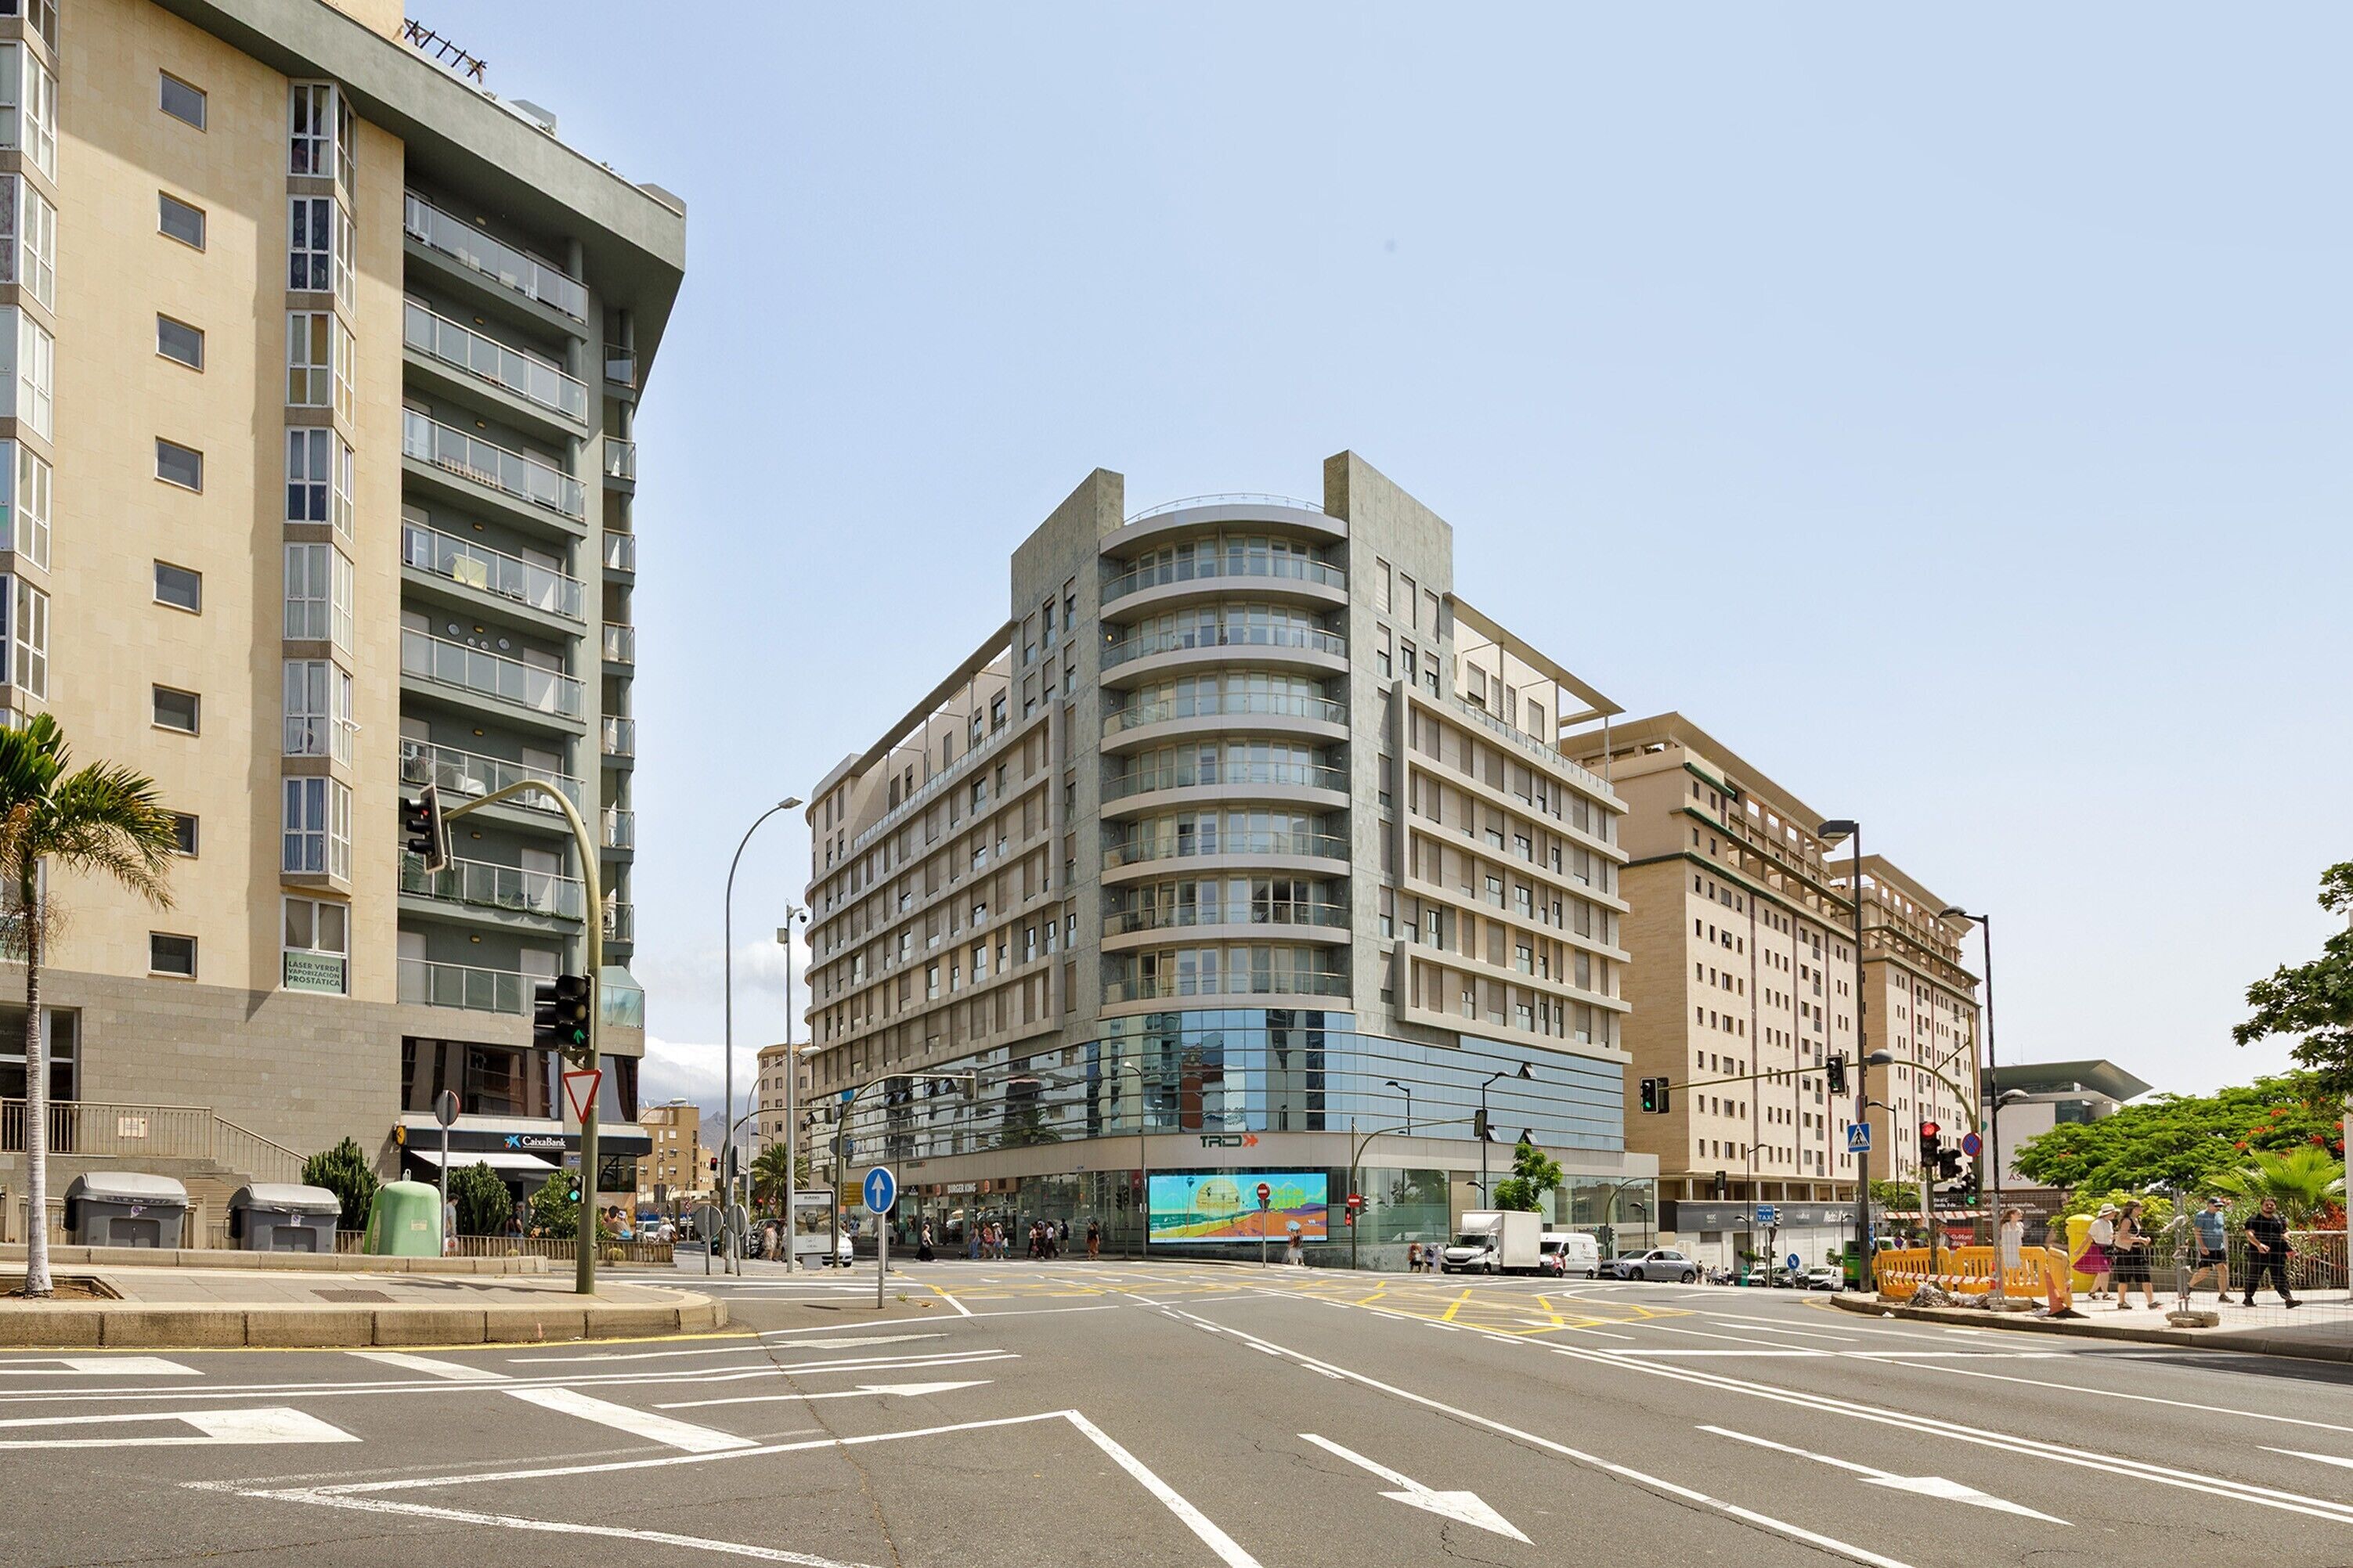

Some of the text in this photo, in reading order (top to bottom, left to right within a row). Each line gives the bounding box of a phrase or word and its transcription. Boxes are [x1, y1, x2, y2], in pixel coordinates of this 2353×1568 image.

[315, 964, 340, 972] VERDE
[522, 1136, 566, 1147] CaixaBank
[1200, 1135, 1243, 1148] TRD
[947, 1184, 964, 1195] BURGER
[965, 1182, 976, 1193] KING
